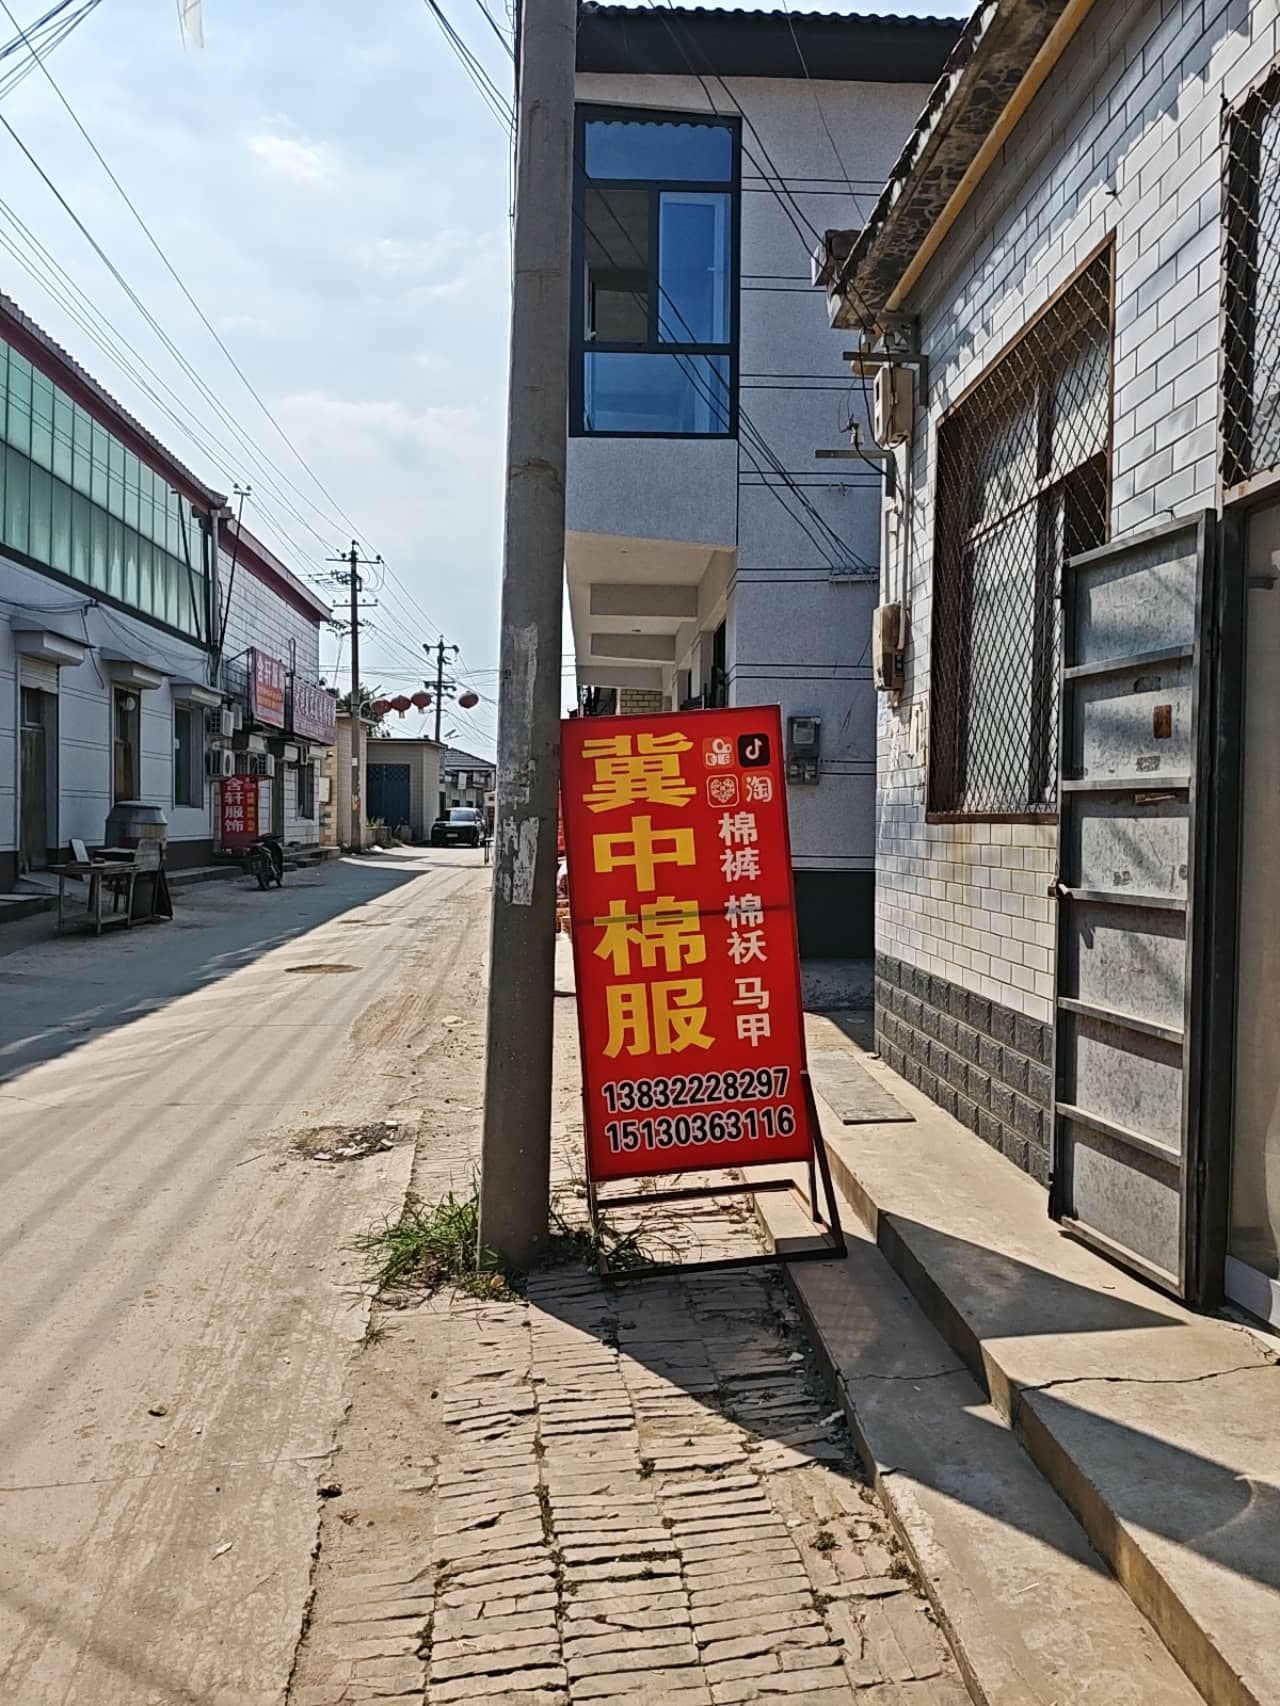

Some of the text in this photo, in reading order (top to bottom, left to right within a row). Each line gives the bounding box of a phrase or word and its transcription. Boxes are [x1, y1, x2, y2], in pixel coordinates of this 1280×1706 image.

[746, 776, 773, 803] 淘
[581, 732, 715, 1058] 冀中棉服
[718, 811, 772, 1047] 棉裤 棉袄 马甲
[602, 1066, 790, 1113] 13832228297
[605, 1105, 795, 1153] 15130363116
